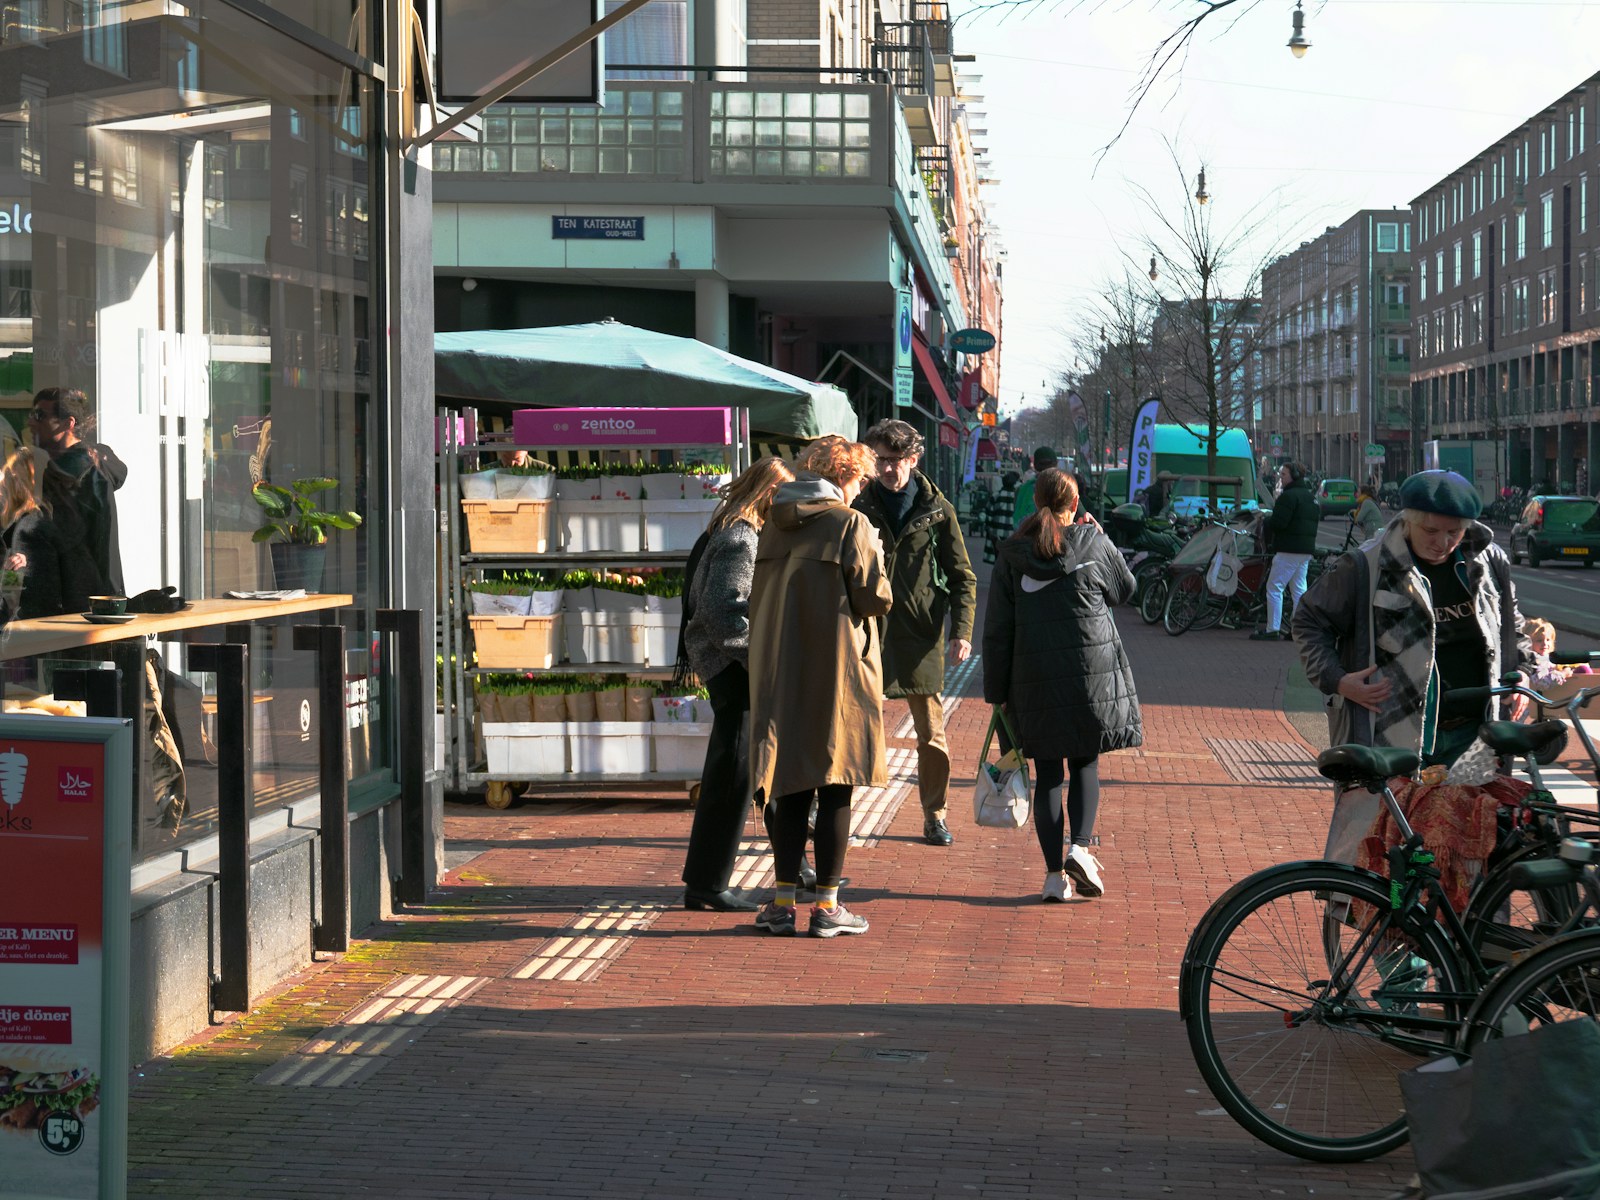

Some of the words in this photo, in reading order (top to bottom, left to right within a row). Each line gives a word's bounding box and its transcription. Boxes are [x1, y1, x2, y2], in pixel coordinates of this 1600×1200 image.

[558, 218, 577, 229] TEN
[583, 219, 637, 229] KATESTRAAT
[605, 230, 637, 238] OUD-WEST
[581, 417, 636, 430] zentoo
[0, 928, 18, 940] ER
[21, 928, 75, 941] MENU
[24, 1009, 70, 1022] döner
